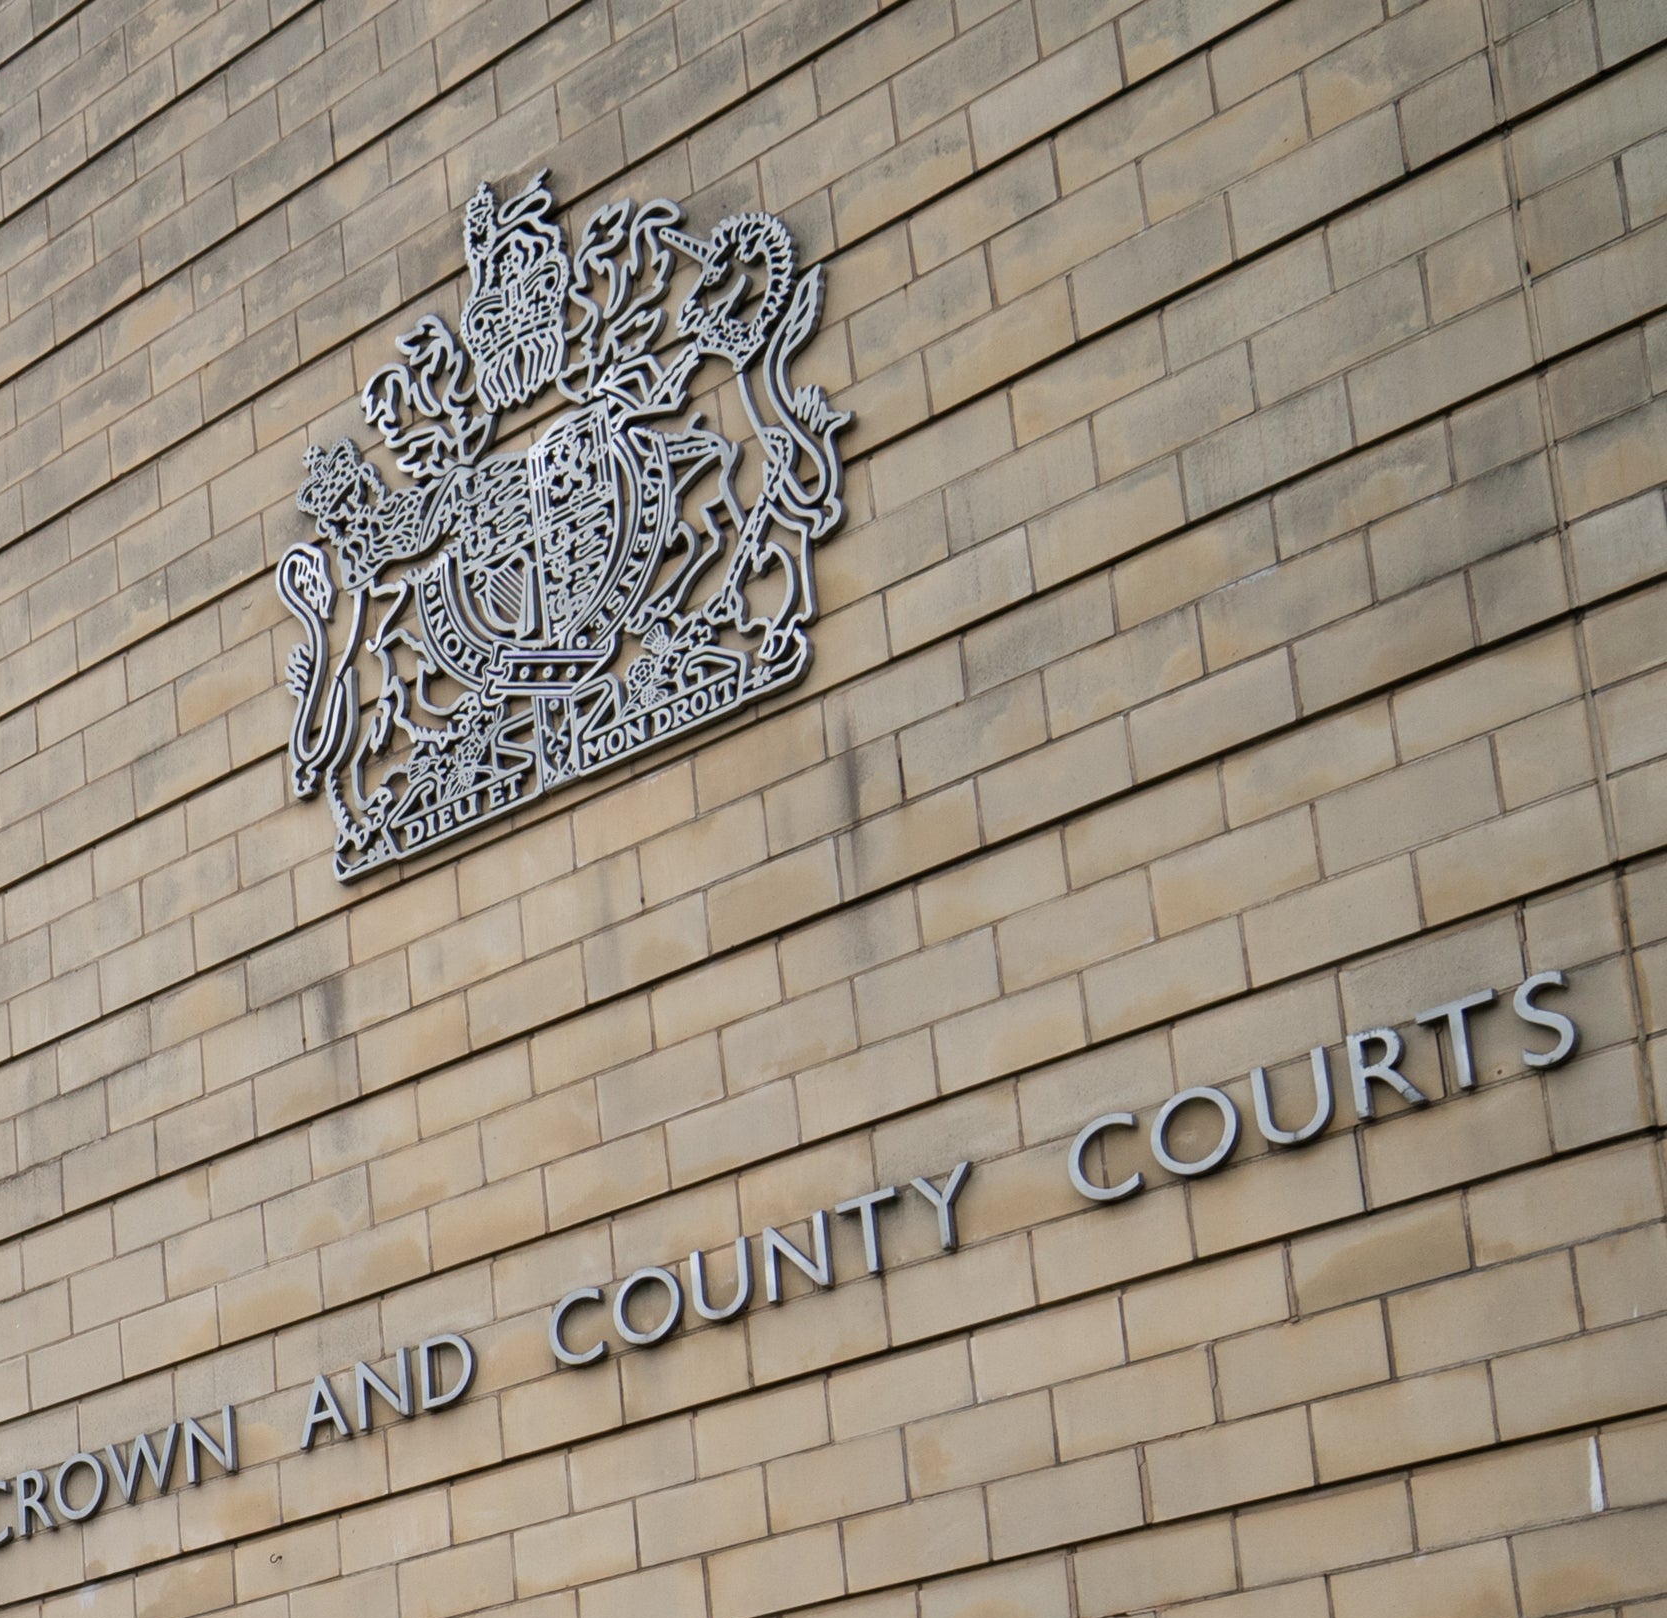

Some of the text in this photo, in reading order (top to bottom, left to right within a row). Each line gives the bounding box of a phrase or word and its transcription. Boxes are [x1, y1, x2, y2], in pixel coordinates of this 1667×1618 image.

[426, 596, 484, 675] HONI
[404, 675, 739, 849] DIEU ET MON DROIT
[300, 1333, 477, 1453] AND
[548, 1160, 973, 1366] COUNTY
[1068, 970, 1581, 1202] COURTS
